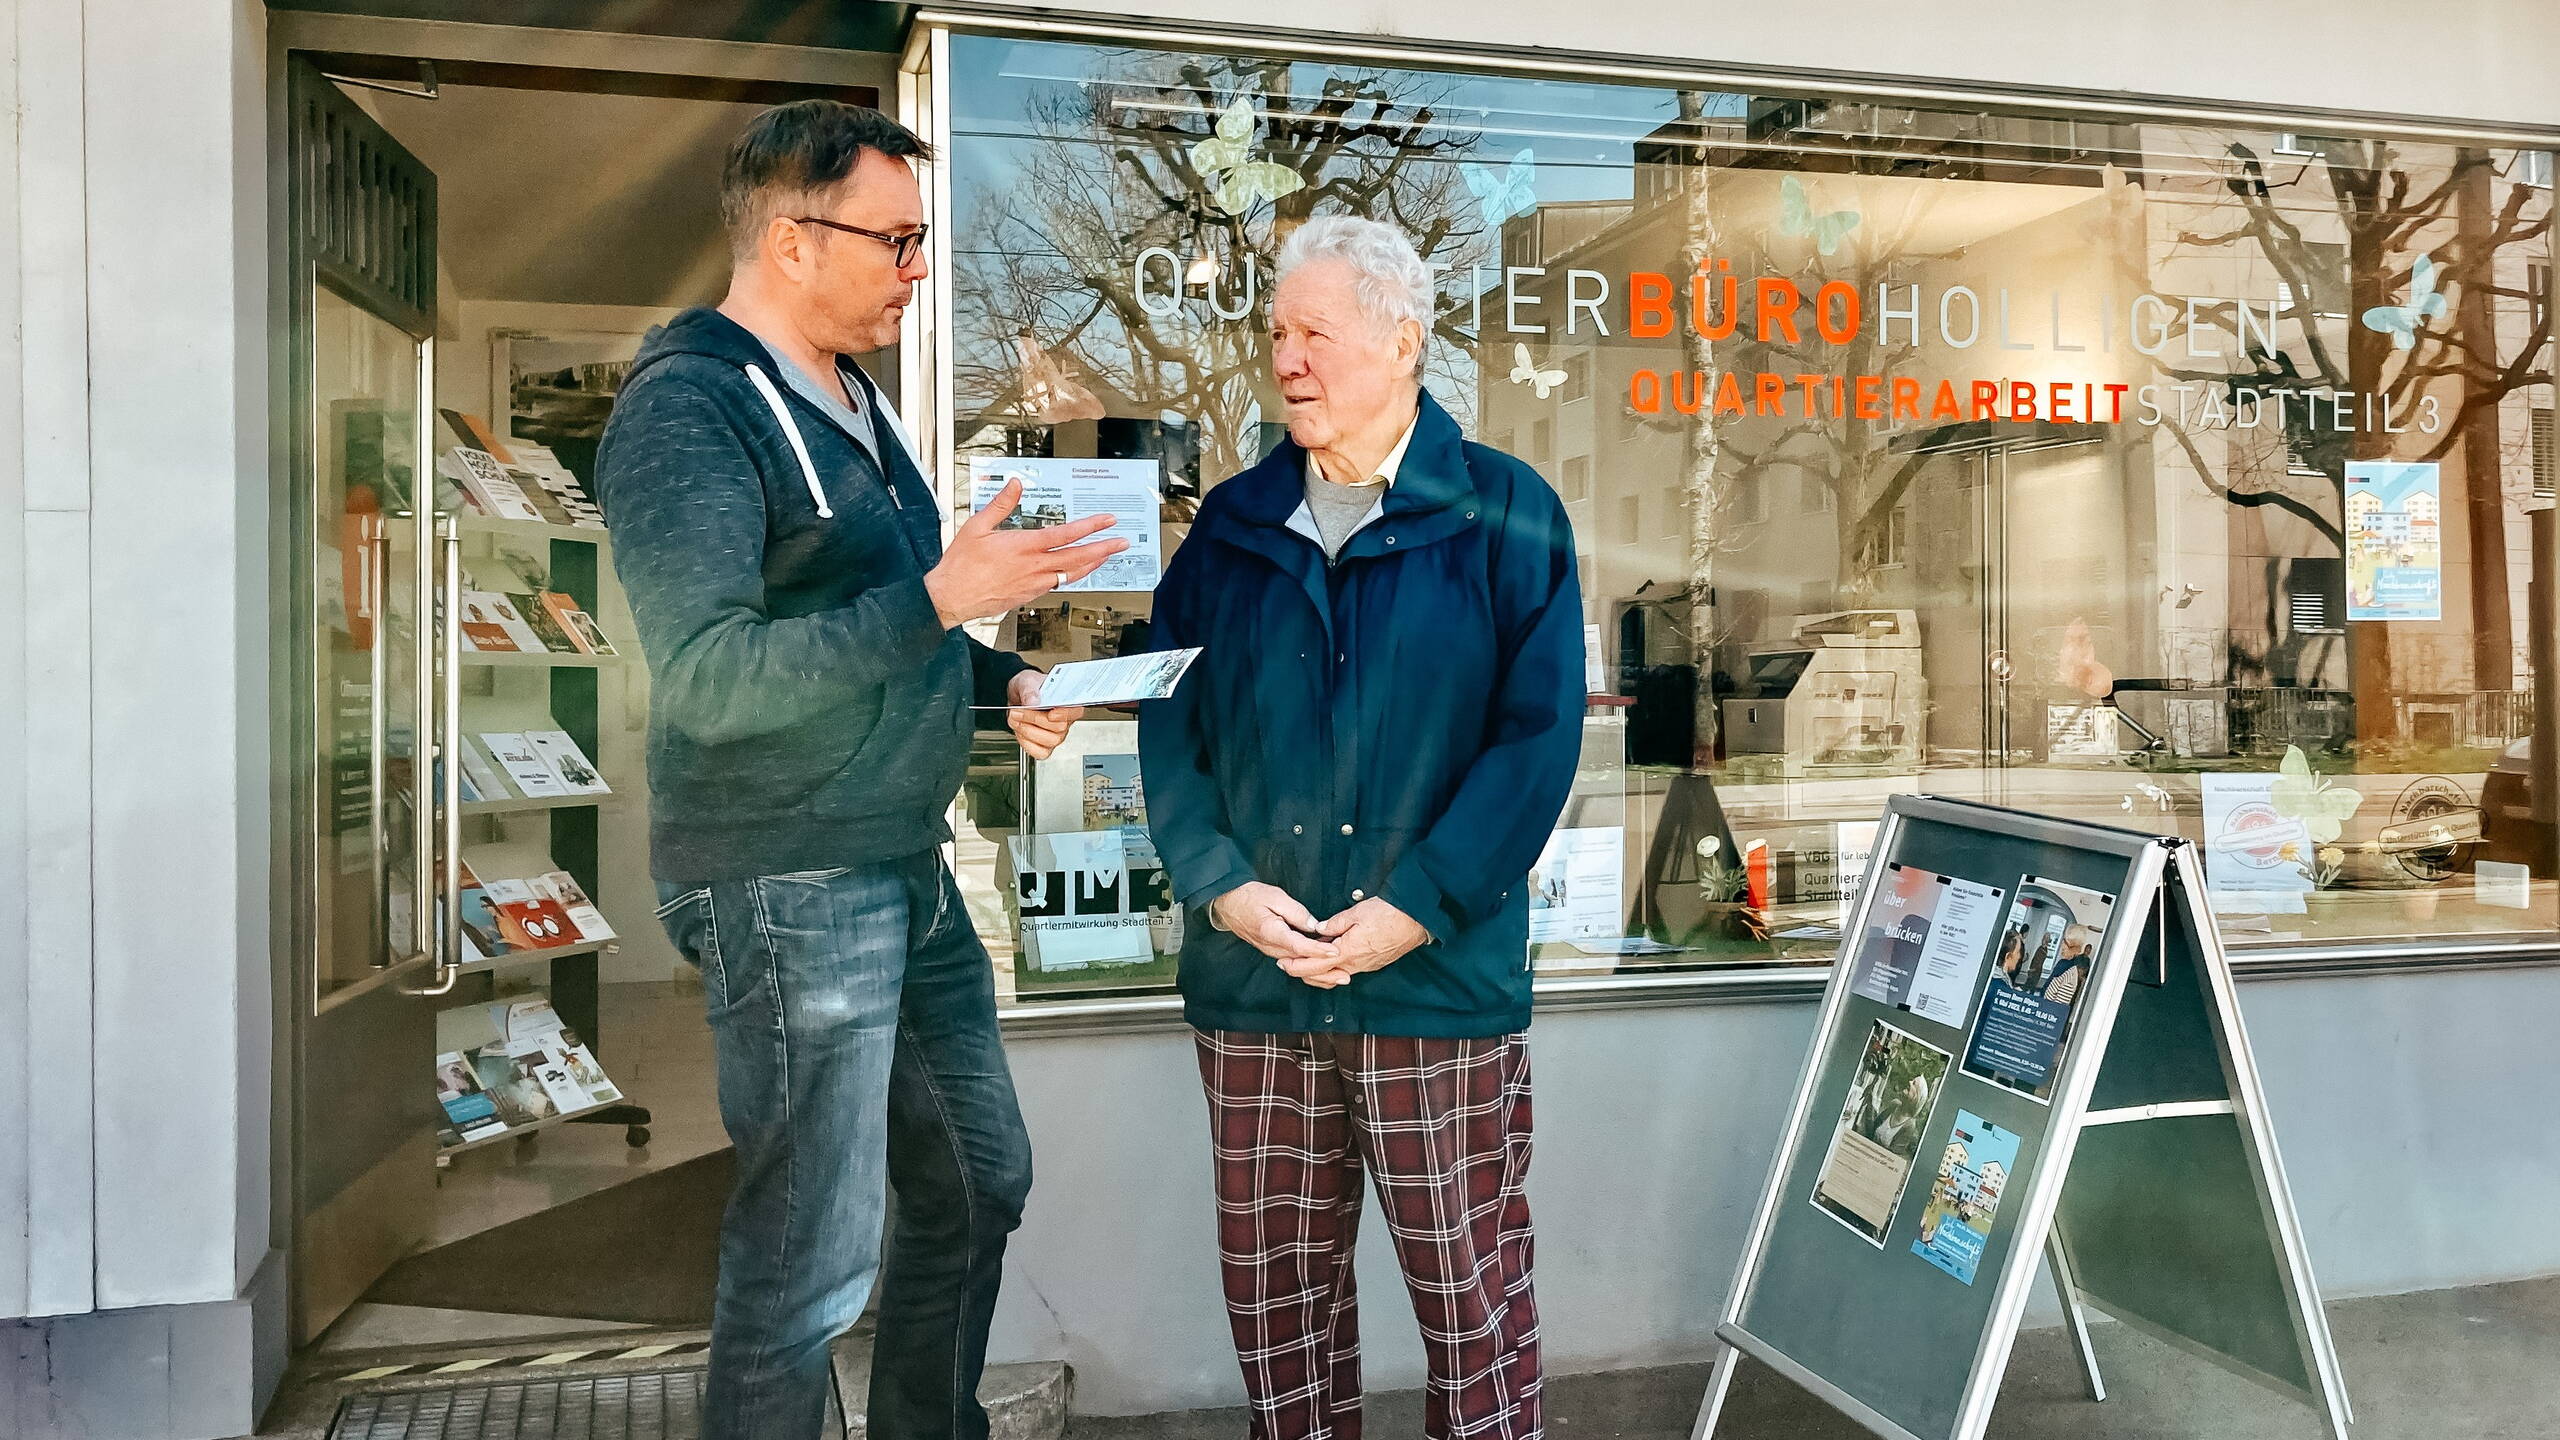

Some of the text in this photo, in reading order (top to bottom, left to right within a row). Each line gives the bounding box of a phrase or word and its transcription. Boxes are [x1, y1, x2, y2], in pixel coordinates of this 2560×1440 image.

[1135, 247, 2277, 360] QUTIERBÜROHOLLIGEN
[2418, 395, 2440, 433] 3
[1883, 889, 1907, 909] über
[1020, 917, 1173, 933] Quartiermitwirkung Stadtteil 3
[1884, 921, 1922, 945] brücken
